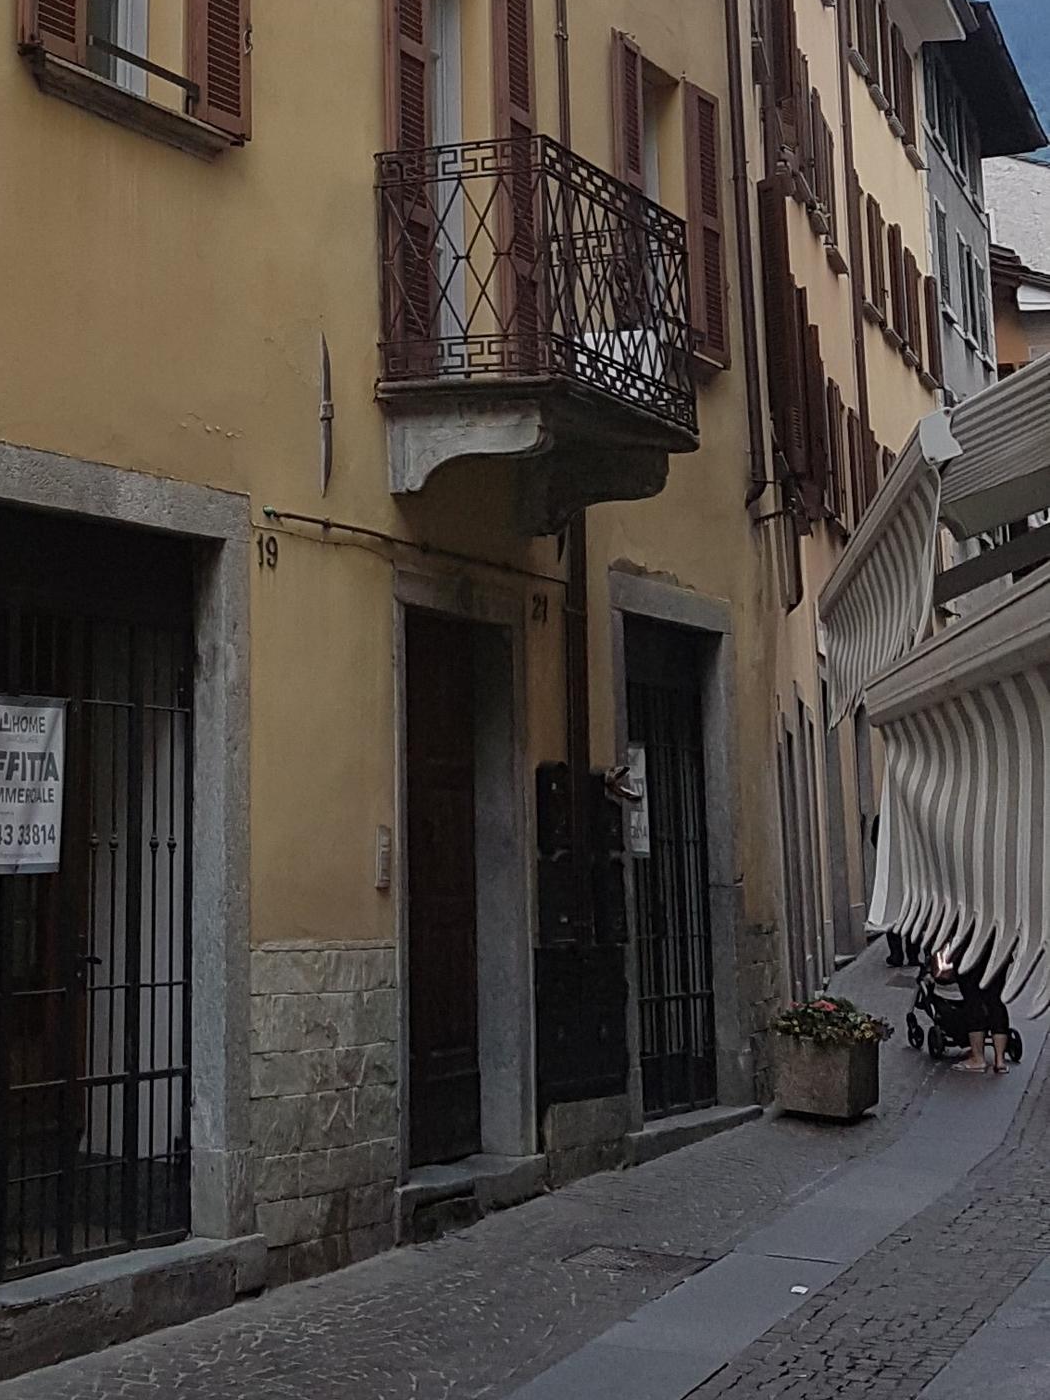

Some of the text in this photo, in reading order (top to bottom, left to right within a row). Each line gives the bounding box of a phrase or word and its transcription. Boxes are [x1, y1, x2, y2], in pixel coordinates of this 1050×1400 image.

[256, 533, 278, 569] 19
[531, 593, 548, 624] 21
[12, 716, 46, 733] HOME
[17, 824, 56, 845] 33814
